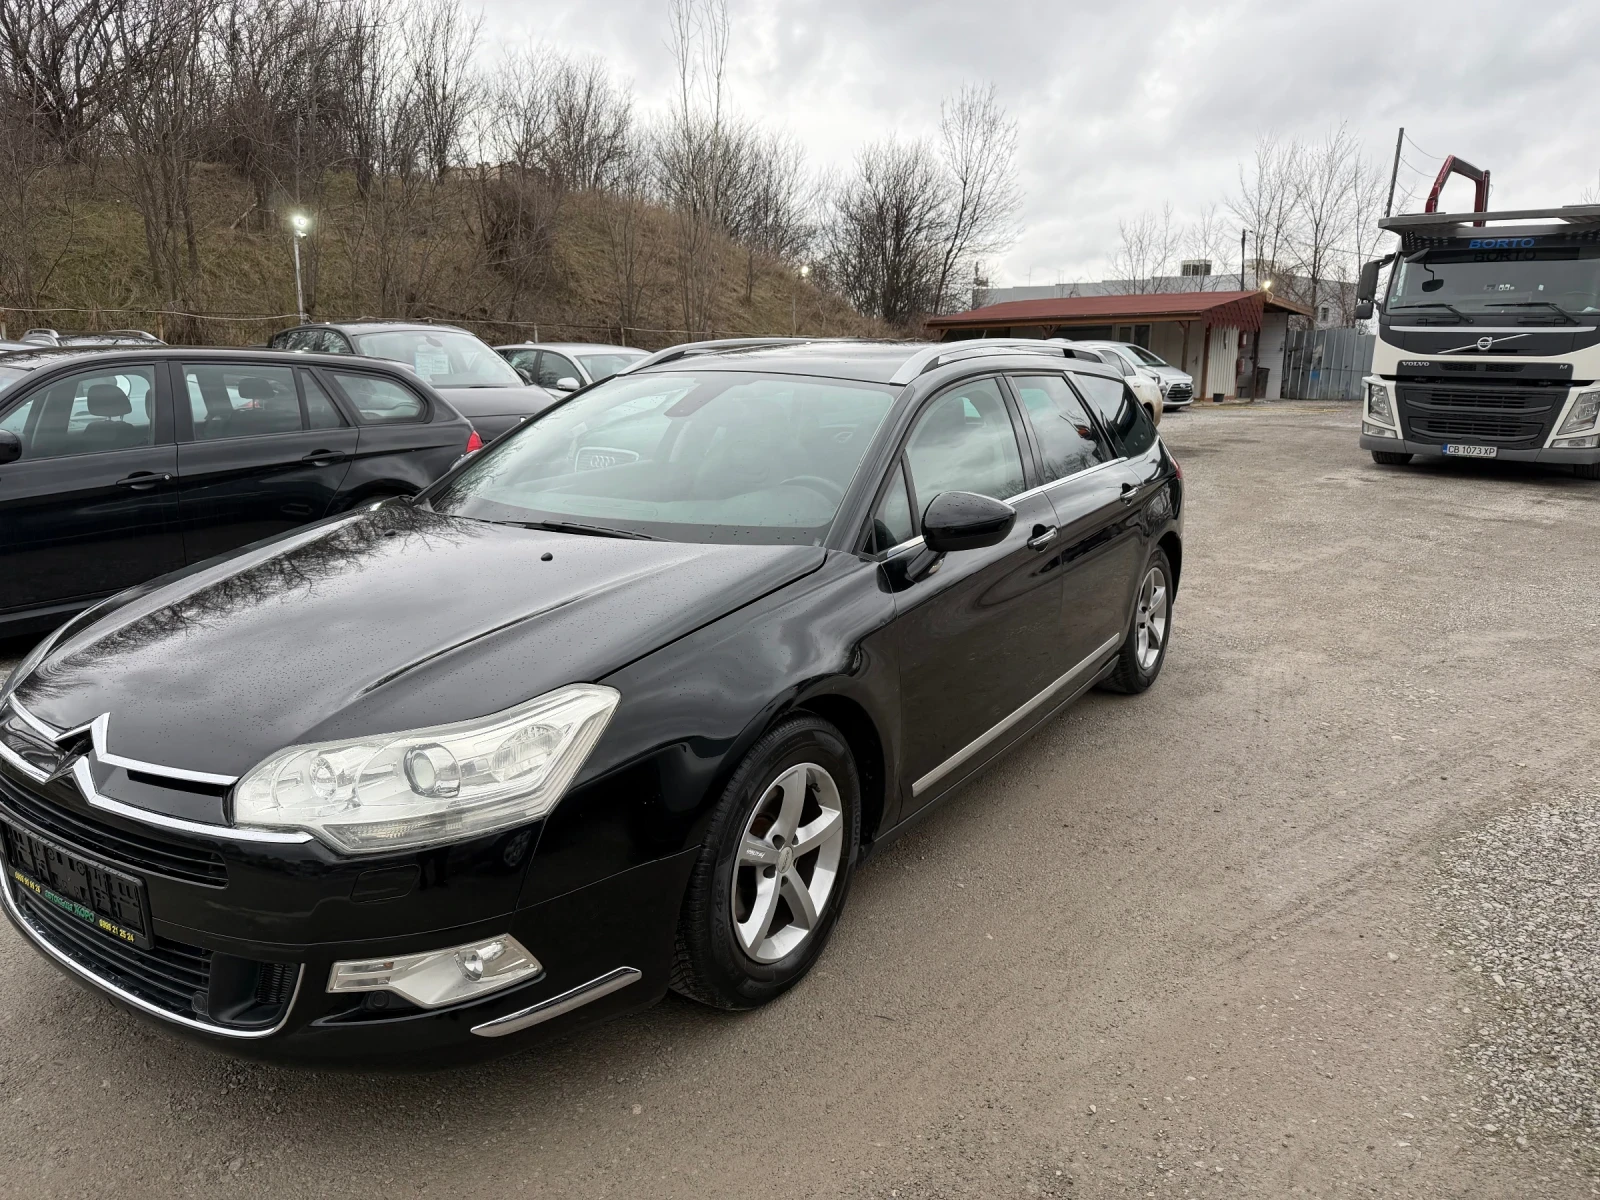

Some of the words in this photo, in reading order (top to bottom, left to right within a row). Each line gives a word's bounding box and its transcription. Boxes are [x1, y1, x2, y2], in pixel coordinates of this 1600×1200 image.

[1469, 238, 1535, 249] BORTO
[1448, 445, 1459, 454] CB
[1462, 446, 1482, 455] 1073
[1483, 447, 1495, 455] XP
